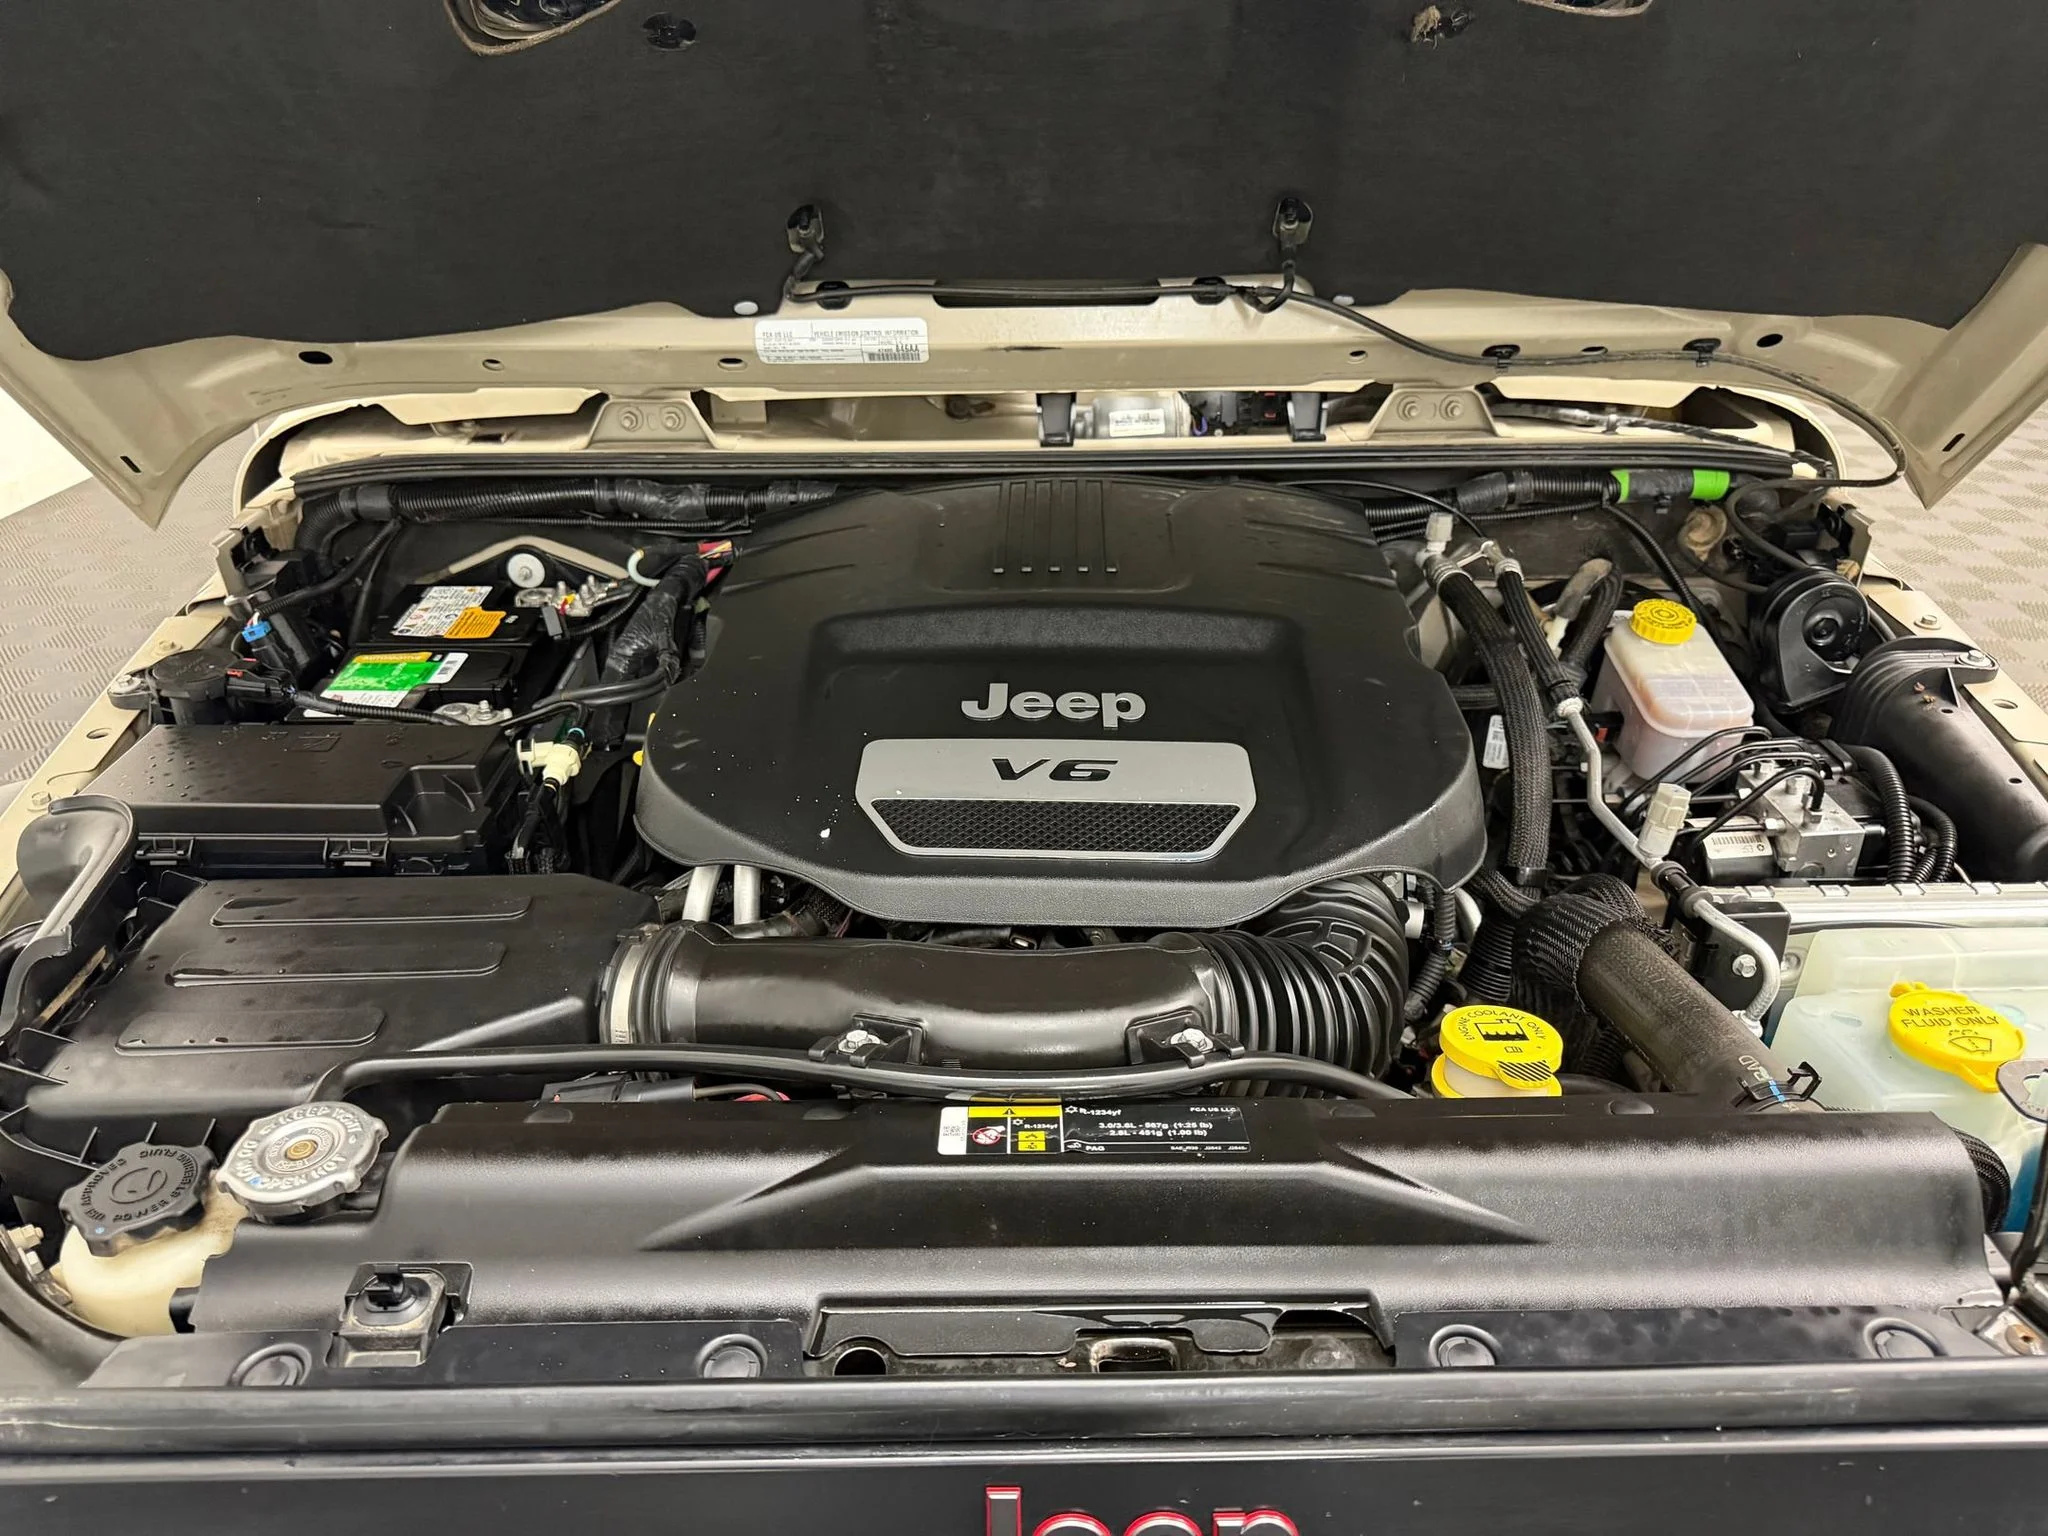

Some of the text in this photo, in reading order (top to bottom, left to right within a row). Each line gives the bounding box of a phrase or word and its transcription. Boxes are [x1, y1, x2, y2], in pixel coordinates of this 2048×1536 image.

[960, 682, 1147, 730] Jeep
[992, 758, 1119, 782] V6
[1901, 1016, 2000, 1028] FLUID ONLY
[1903, 1005, 1981, 1017] WASHER
[1467, 1009, 1526, 1021] COOLANT
[1526, 1021, 1547, 1041] ONLY
[279, 1106, 330, 1124] KEEP
[1079, 1107, 1122, 1117] R-1234yf
[1024, 1122, 1058, 1130] R-1234yf
[311, 1153, 346, 1179] HOT
[80, 1158, 127, 1207] APPROVED
[113, 1149, 197, 1223] POWER STEERING FLUID
